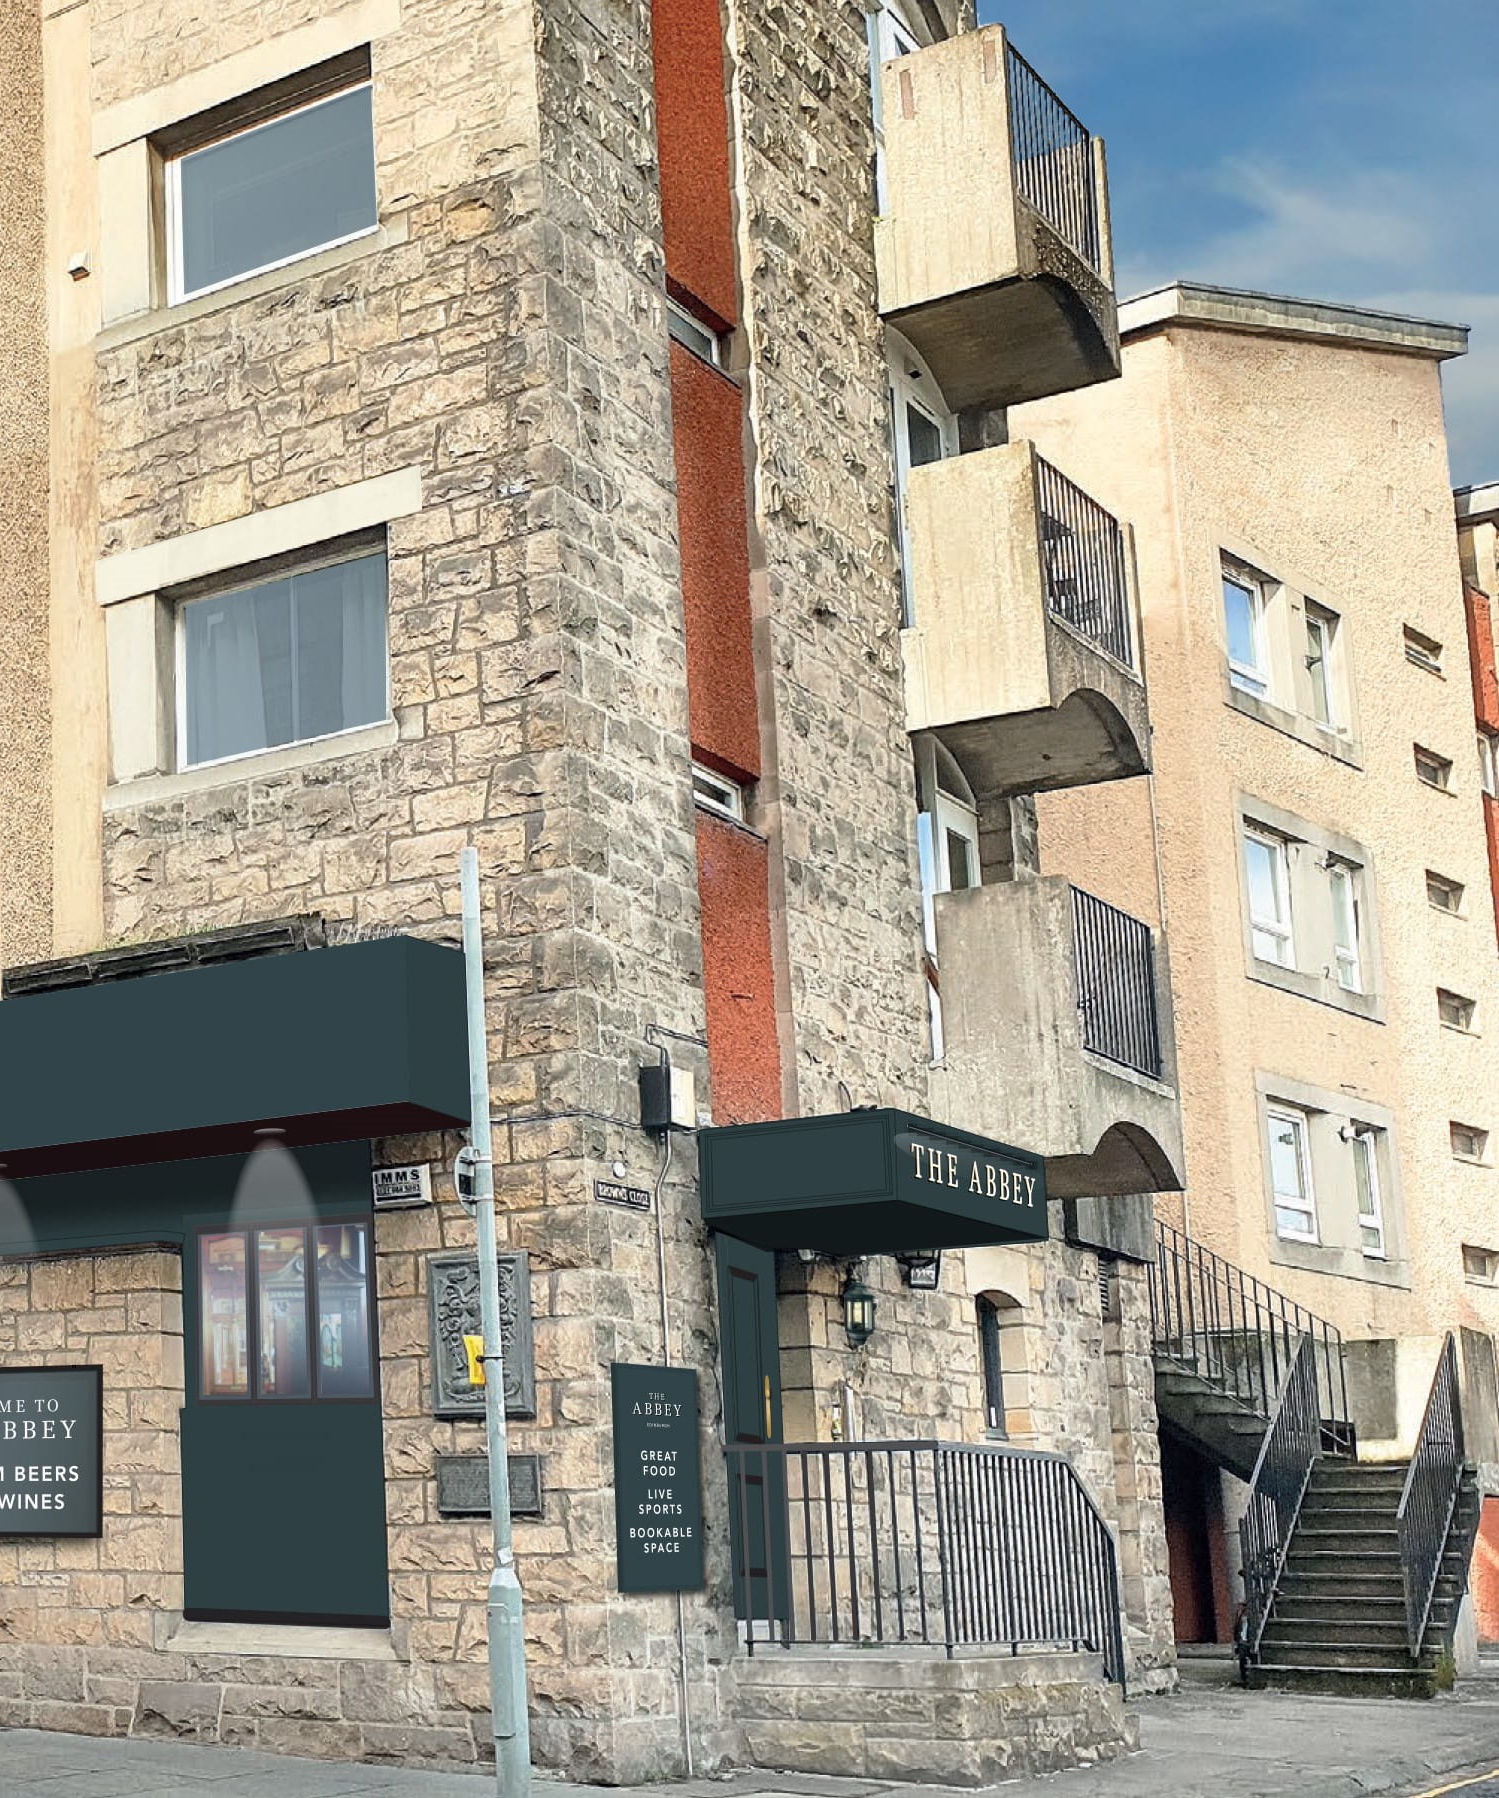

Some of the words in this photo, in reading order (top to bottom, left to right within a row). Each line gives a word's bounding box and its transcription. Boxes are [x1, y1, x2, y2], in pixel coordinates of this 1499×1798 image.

[912, 1143, 958, 1187] THE
[969, 1161, 1035, 1207] ABBEY
[35, 1399, 58, 1412] TO
[633, 1402, 681, 1416] ABBEY
[641, 1450, 677, 1461] GREAT
[15, 1466, 78, 1481] BEERS
[643, 1466, 675, 1476] FOOD
[648, 1489, 672, 1499] LIVE
[639, 1504, 682, 1514] SPORTS
[630, 1527, 692, 1538] BOOKABLE
[644, 1543, 679, 1553] SPACE
